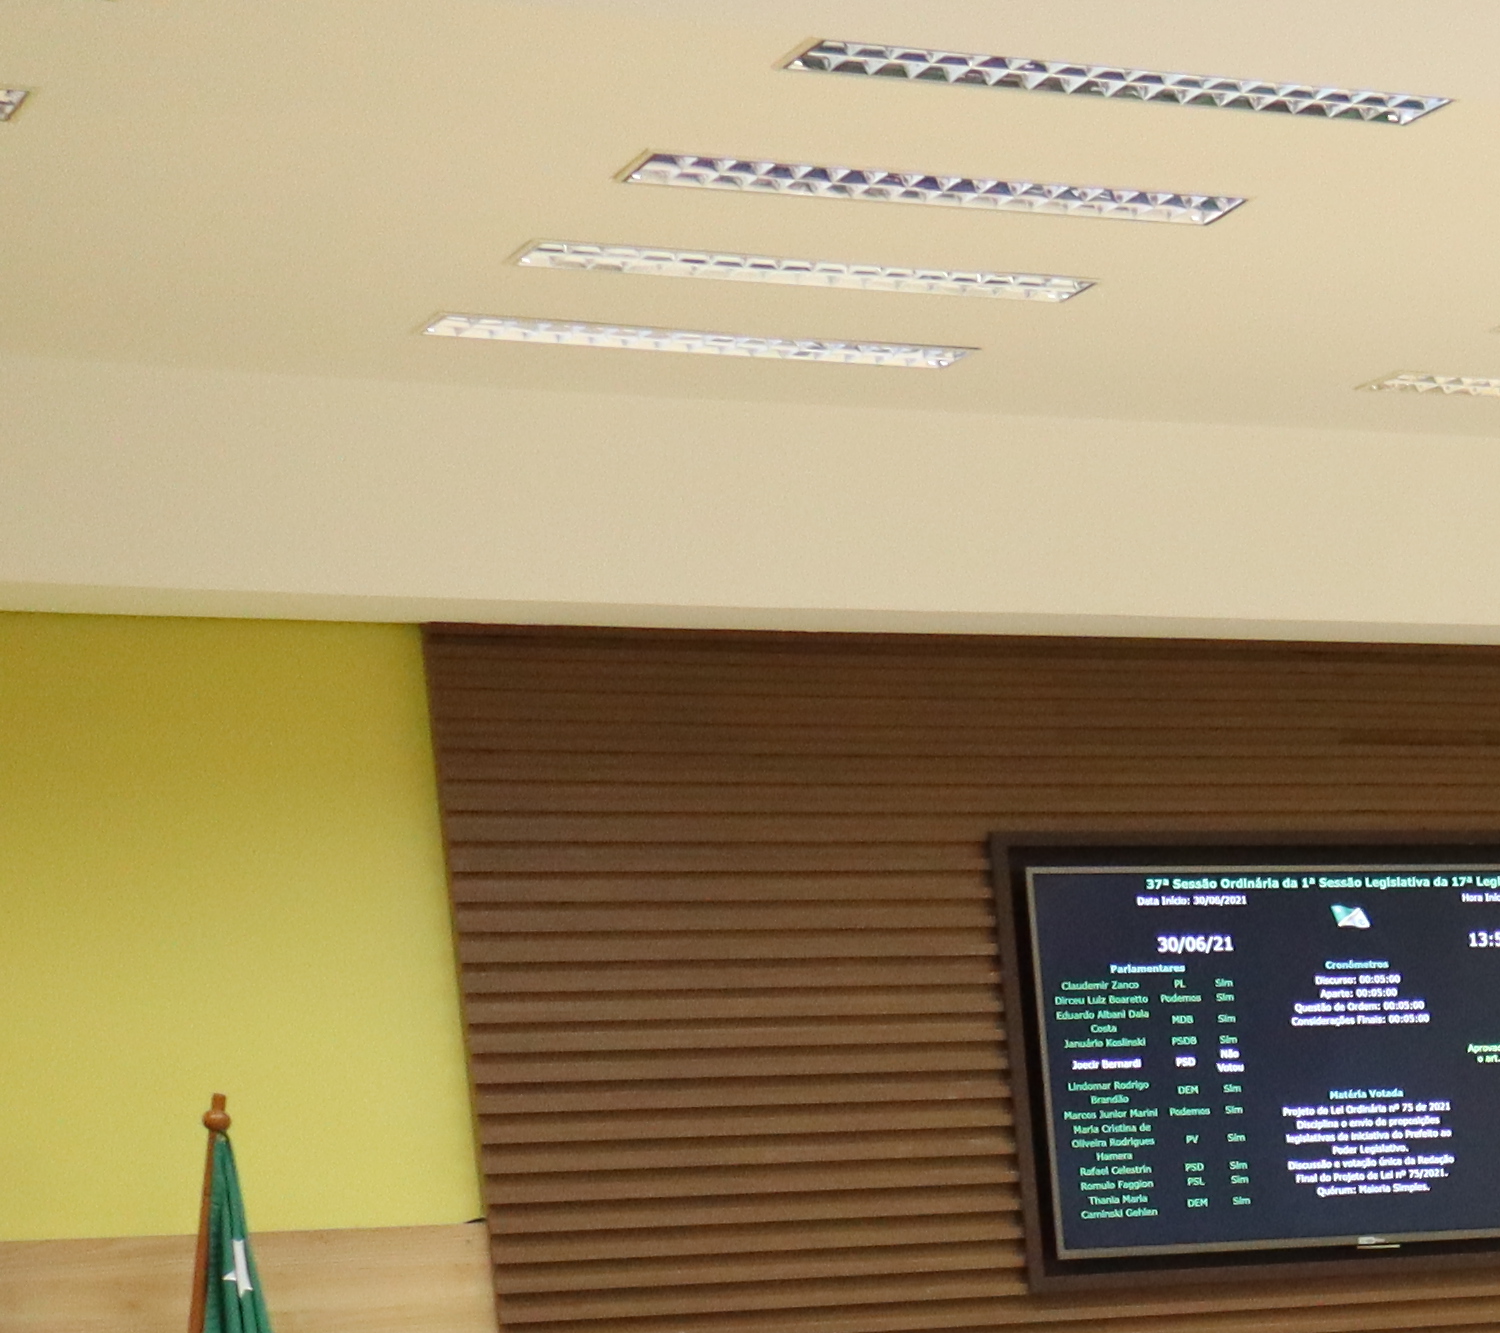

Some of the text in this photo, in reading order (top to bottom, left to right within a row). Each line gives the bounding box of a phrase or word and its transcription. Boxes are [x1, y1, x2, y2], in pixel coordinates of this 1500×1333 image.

[1146, 877, 1170, 890] 37ª
[1172, 877, 1218, 890] Sessão
[1220, 877, 1280, 889] Ordinária
[1282, 877, 1298, 889] da
[1301, 877, 1316, 889] 1ª
[1318, 876, 1362, 889] Sessão
[1365, 876, 1431, 890] Legislativa
[1433, 876, 1449, 888] da
[1451, 875, 1473, 888] 17ª
[1136, 895, 1248, 907] Data Início: 30/06/2021
[1461, 892, 1483, 903] Hora
[1157, 935, 1234, 954] 30/06/21
[1110, 964, 1186, 975] Parlamentares
[1325, 960, 1390, 970] Cronômetros
[1061, 978, 1234, 991] Claudemir Zanco PL Sim
[1315, 974, 1401, 985] Discurso: 00:05:00
[1054, 992, 1235, 1006] Dirceu Luiz Boaretto Podemos Sim
[1320, 988, 1398, 999] Aparte: 00:05:00
[1294, 1000, 1425, 1014] Questão Ordem: 00:05:00
[1055, 1009, 1237, 1025] Eduardo Albani MDB Sim
[1291, 1013, 1430, 1027] Considerações Finais: 00:05:00
[1090, 1024, 1117, 1033] Costa
[1064, 1035, 1238, 1049] Januário PSDB Sim
[1072, 1048, 1240, 1071] Joecir Bernardi PSD Não
[1216, 1062, 1245, 1073] Votou
[1068, 1081, 1242, 1095] Lindomar Rodrigo DEM Sim
[1329, 1088, 1404, 1100] Matéria Votada
[1063, 1110, 1097, 1120] Marcos
[1129, 1108, 1158, 1118] Marini
[1169, 1106, 1211, 1116] Podemos
[1224, 1105, 1244, 1115] Sim
[1282, 1102, 1451, 1118] Projeto Lei Ordinária 75 2021
[1073, 1123, 1137, 1135] Maria Cristina
[1296, 1119, 1339, 1130] Disciplina
[1389, 1115, 1440, 1128] proposições
[1070, 1133, 1246, 1149] Oliveira Rodrigues PV Sim
[1332, 1145, 1358, 1155] Poder
[1079, 1161, 1248, 1176] Rafael Celestrin PSD Sim
[1288, 1160, 1333, 1171] Discussão
[1342, 1158, 1378, 1169] votação
[1417, 1155, 1455, 1166] Redação
[1080, 1181, 1116, 1191] Romulo
[1186, 1177, 1206, 1187] PSL
[1230, 1175, 1250, 1184] Sim
[1295, 1170, 1394, 1184] Final Projeto Lei
[1317, 1186, 1357, 1197] Quórum:
[1358, 1184, 1391, 1194] Maioria
[1122, 1194, 1149, 1204] Maria
[1186, 1198, 1209, 1208] DEM
[1232, 1196, 1251, 1206] Sim
